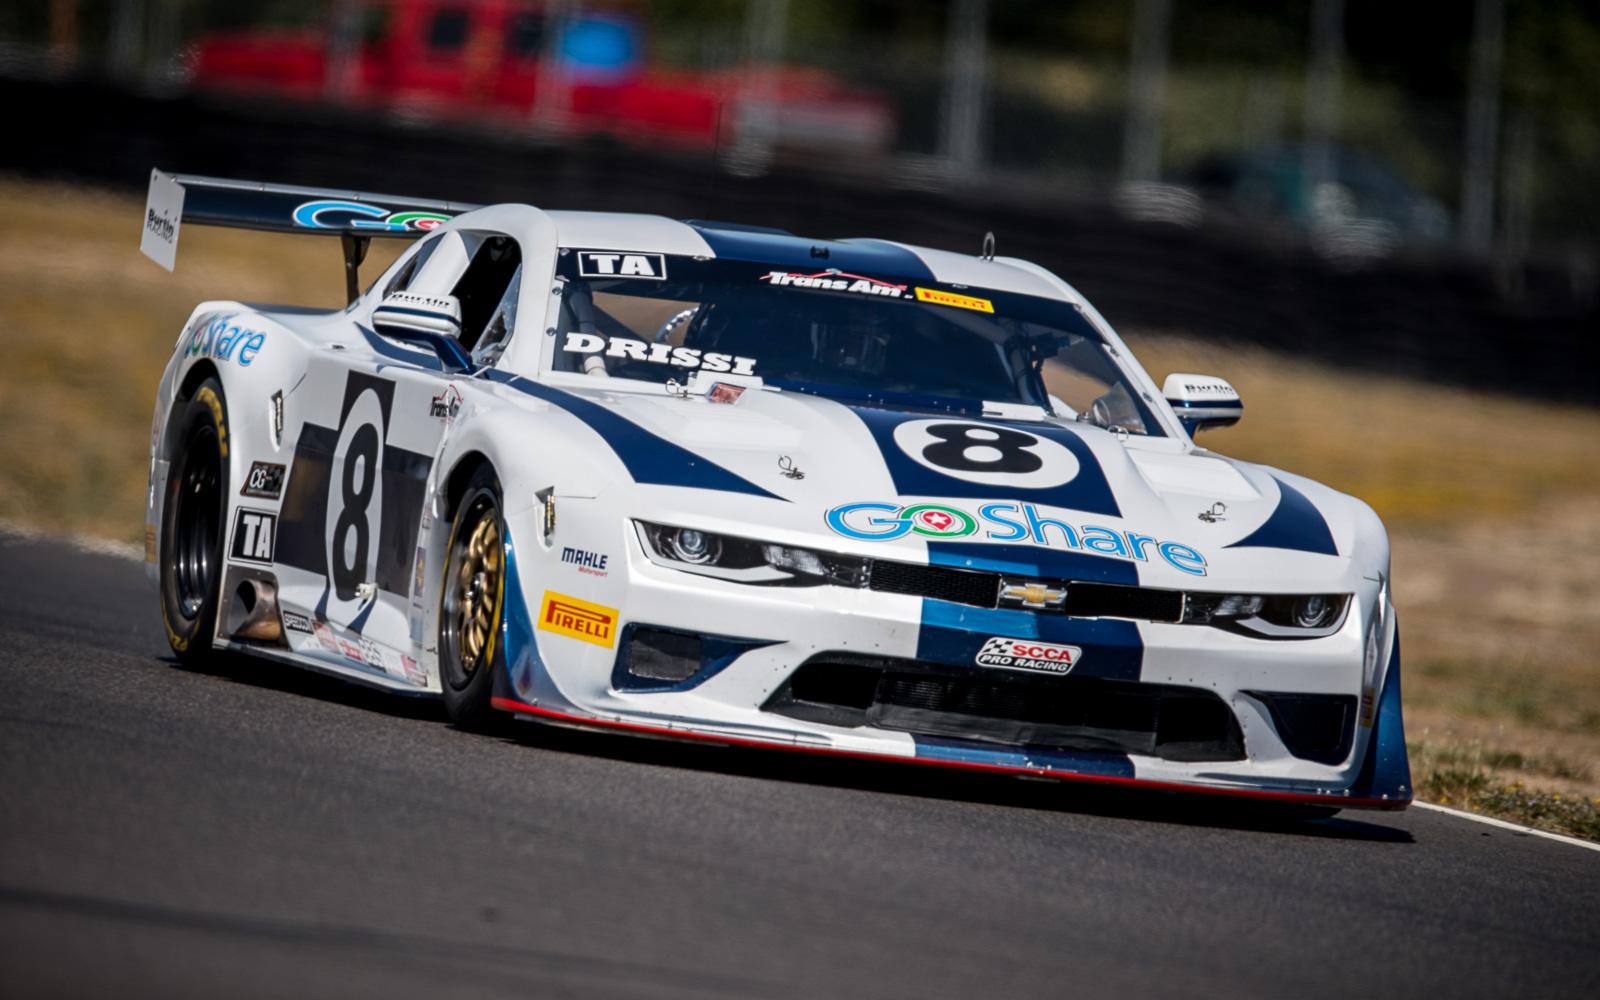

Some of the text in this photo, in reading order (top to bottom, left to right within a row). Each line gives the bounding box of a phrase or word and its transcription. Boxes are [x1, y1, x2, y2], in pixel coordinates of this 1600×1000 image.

[589, 253, 655, 276] TA
[923, 290, 986, 309] PIRELLI
[563, 332, 757, 376] DRISSI
[922, 423, 1044, 474] 8
[332, 422, 379, 601] 8
[243, 514, 272, 559] TA
[561, 546, 608, 570] MAHLE
[545, 600, 611, 639] PIRELLI
[980, 654, 1068, 672] PRO RACING
[1012, 644, 1072, 662] SCCA
